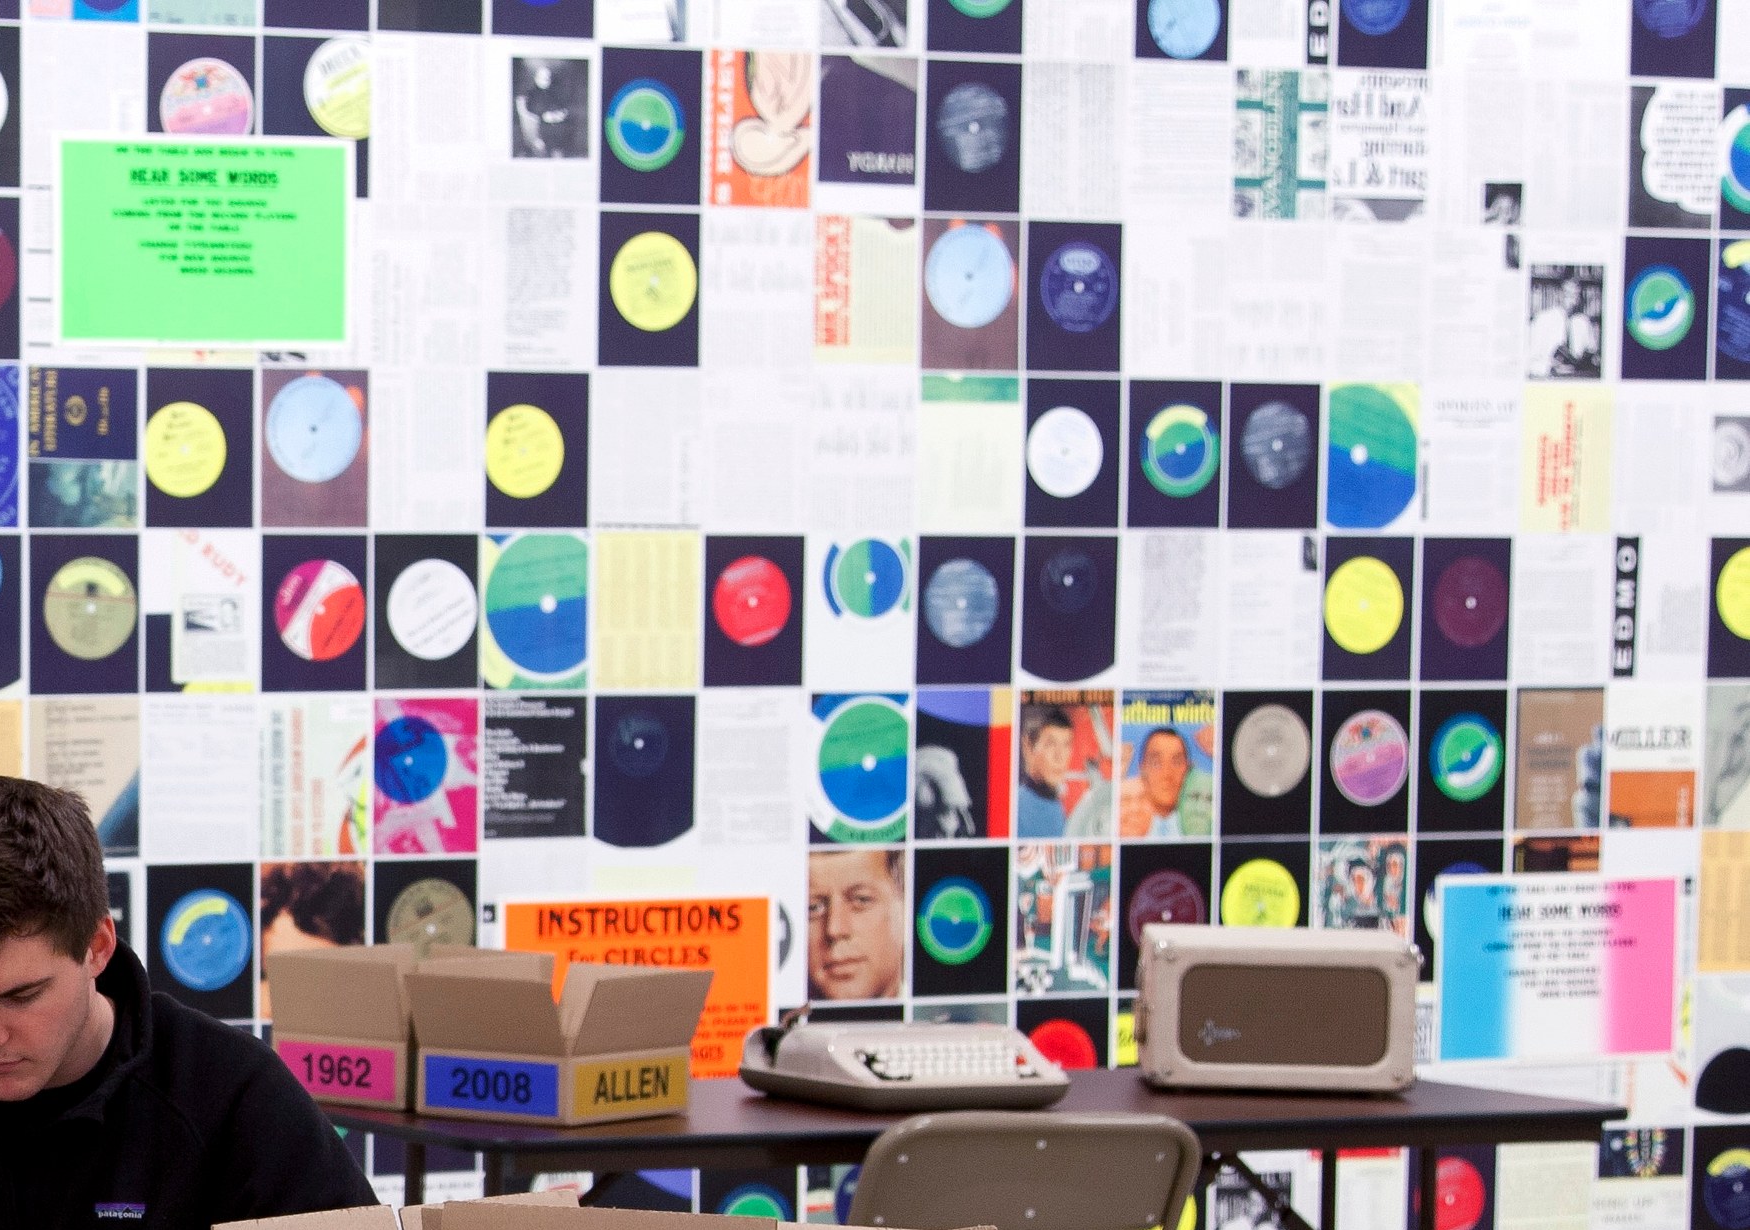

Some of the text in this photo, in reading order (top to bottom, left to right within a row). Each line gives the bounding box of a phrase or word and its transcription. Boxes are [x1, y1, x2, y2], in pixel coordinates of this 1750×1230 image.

[537, 903, 743, 938] INSTRUCTIONS
[604, 944, 711, 967] CIRCLES
[302, 1052, 374, 1090] 1962
[450, 1066, 533, 1105] 2008
[593, 1064, 671, 1106] ALLEN
[97, 1210, 143, 1220] patagonia
